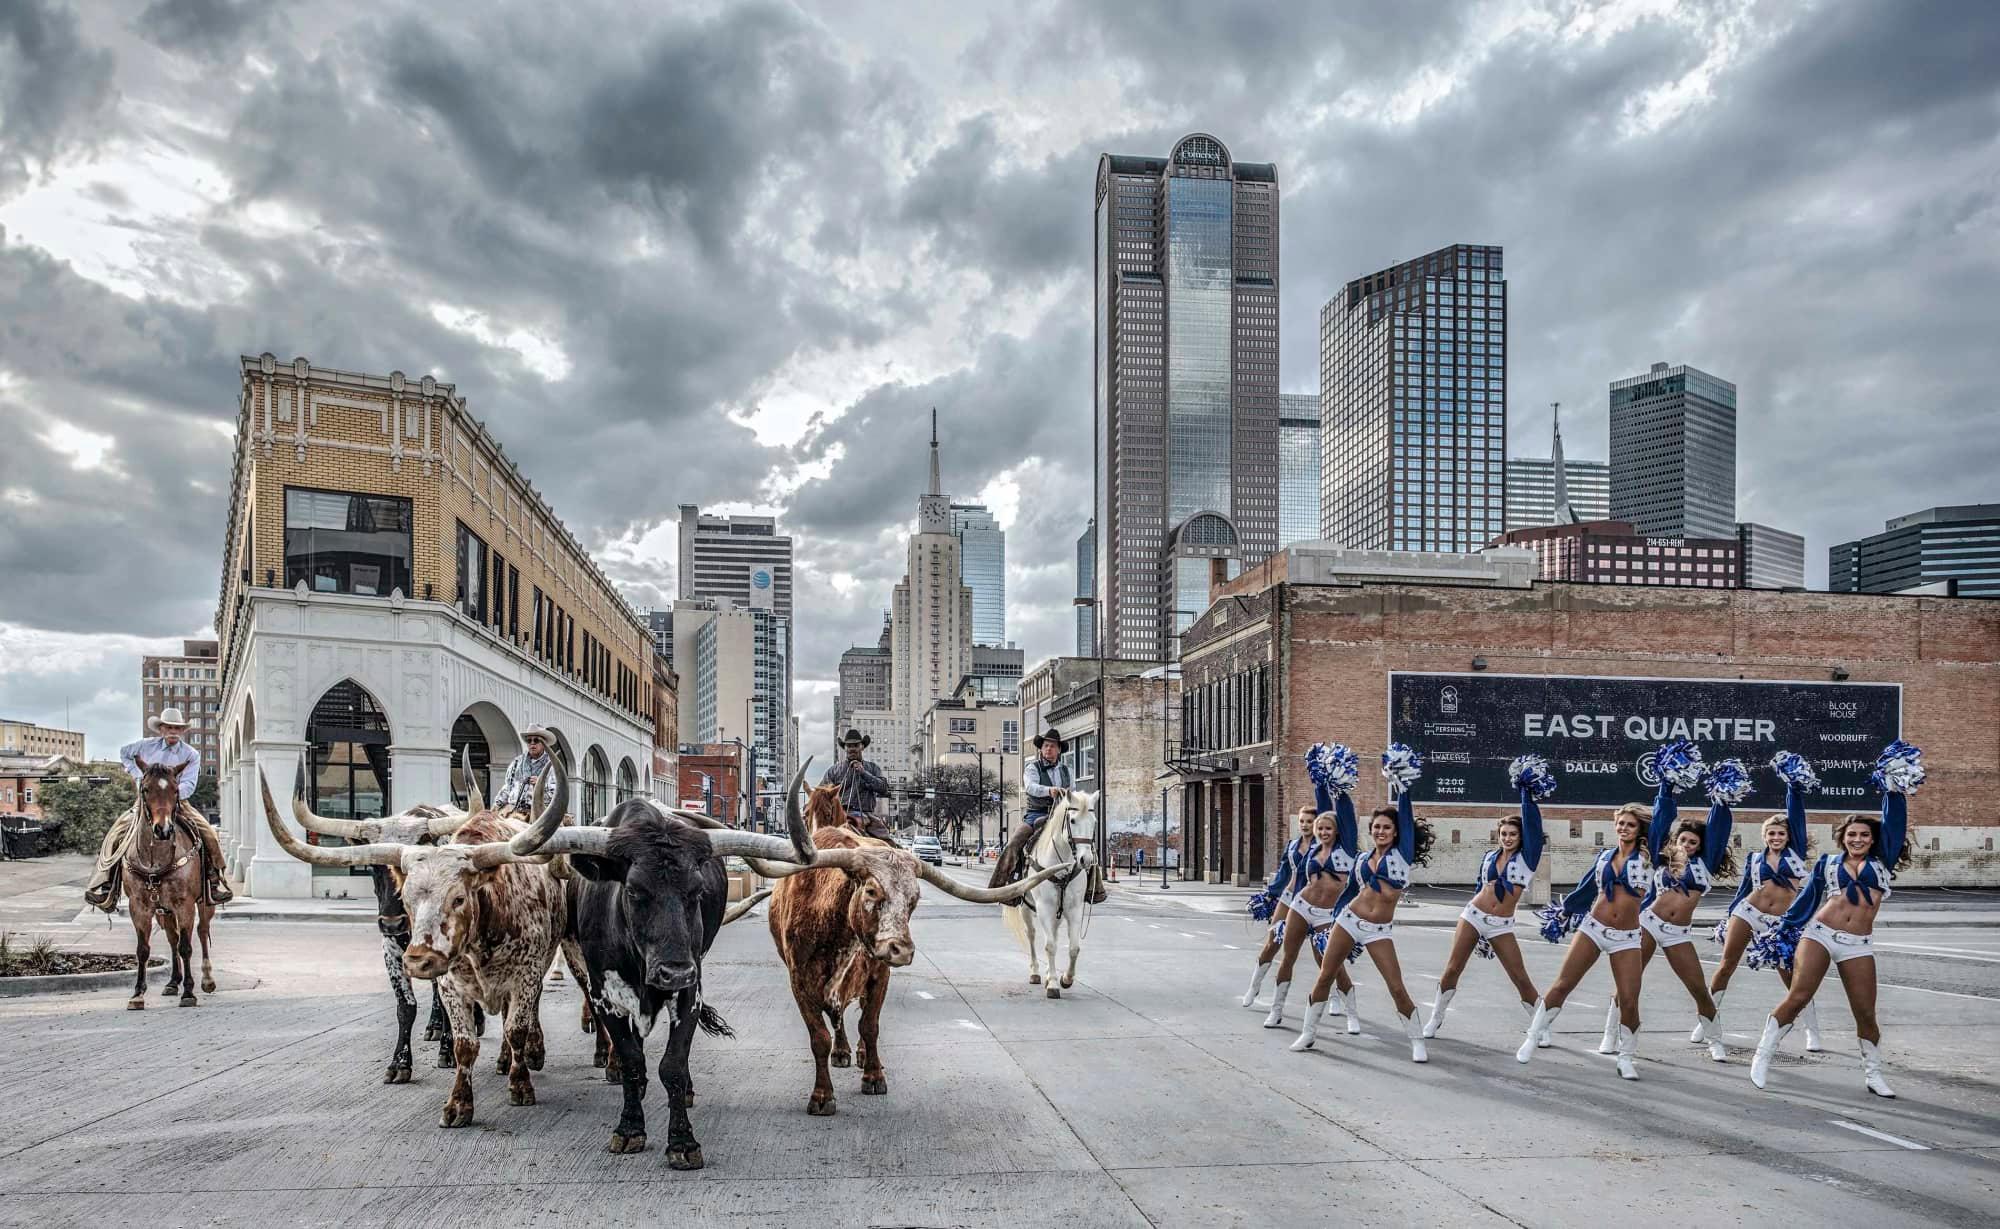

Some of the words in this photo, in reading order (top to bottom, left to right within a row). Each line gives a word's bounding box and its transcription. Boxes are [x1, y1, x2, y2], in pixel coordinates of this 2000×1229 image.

[1829, 701, 1857, 710] BLOCK
[1524, 713, 1615, 738] EAST
[1624, 716, 1776, 742] QUARTER
[1436, 752, 1466, 761] WATERS
[1565, 763, 1618, 773] DALLAS
[1438, 778, 1465, 786] 2200
[1822, 786, 1865, 795] MELETIO
